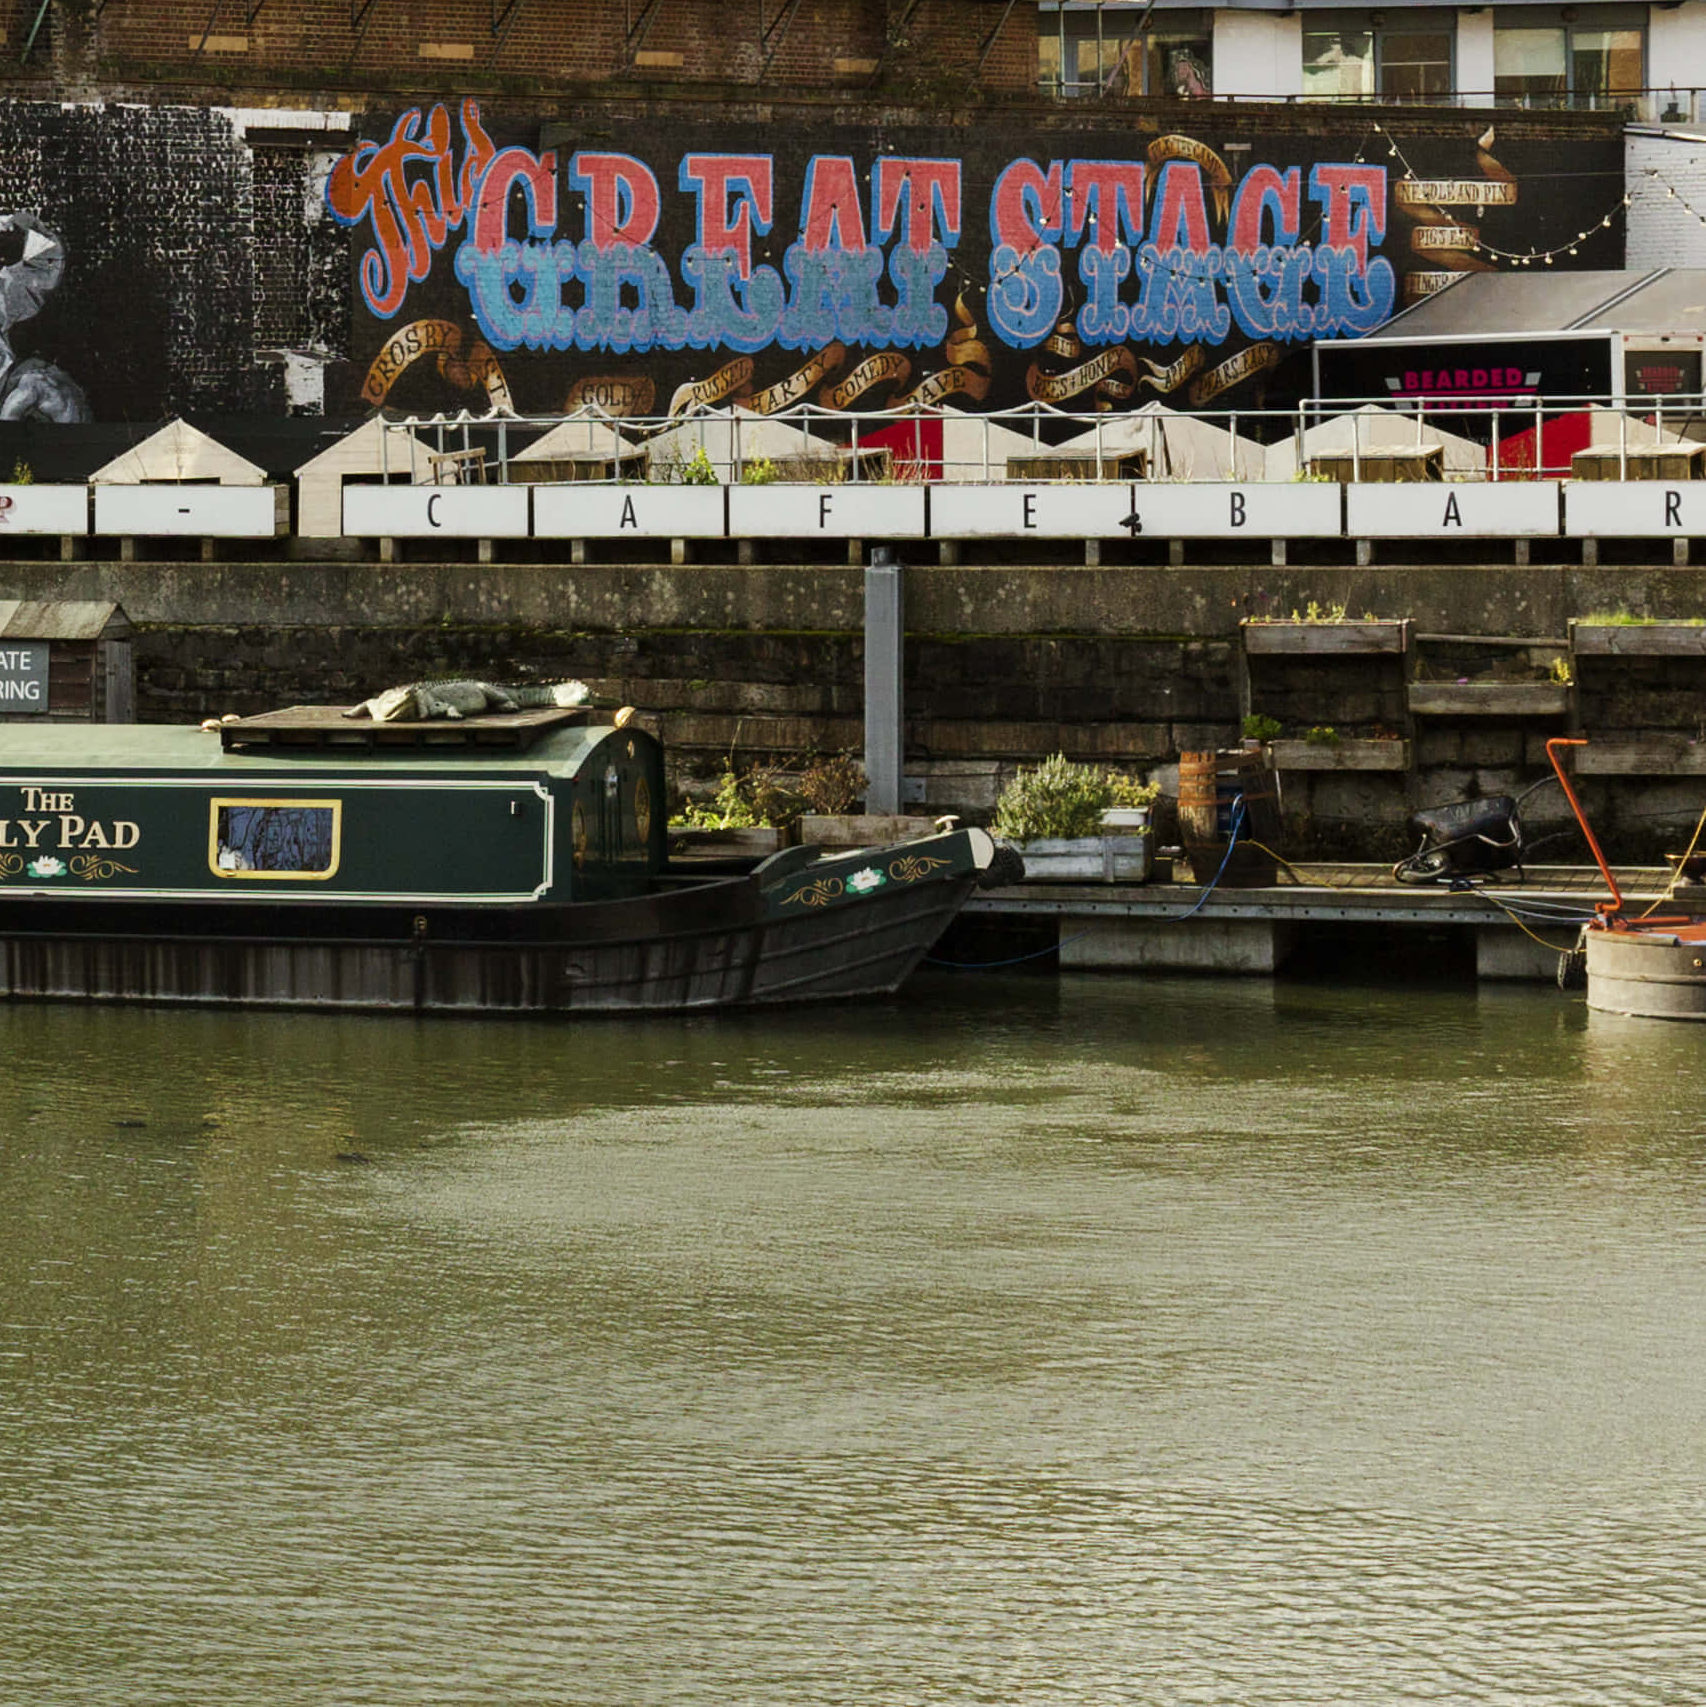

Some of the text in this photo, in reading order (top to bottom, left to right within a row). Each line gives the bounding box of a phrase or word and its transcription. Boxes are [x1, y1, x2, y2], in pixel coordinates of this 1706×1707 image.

[325, 97, 496, 319] This
[1456, 182, 1480, 202] AND
[455, 146, 1396, 354] GREAT STAGE
[367, 324, 453, 398] CROSBY
[750, 352, 830, 414] HARTY
[833, 354, 904, 406] COMEDY
[1079, 348, 1125, 387] HONEY
[1404, 367, 1523, 390] BEARDED
[581, 381, 636, 408] GOLD
